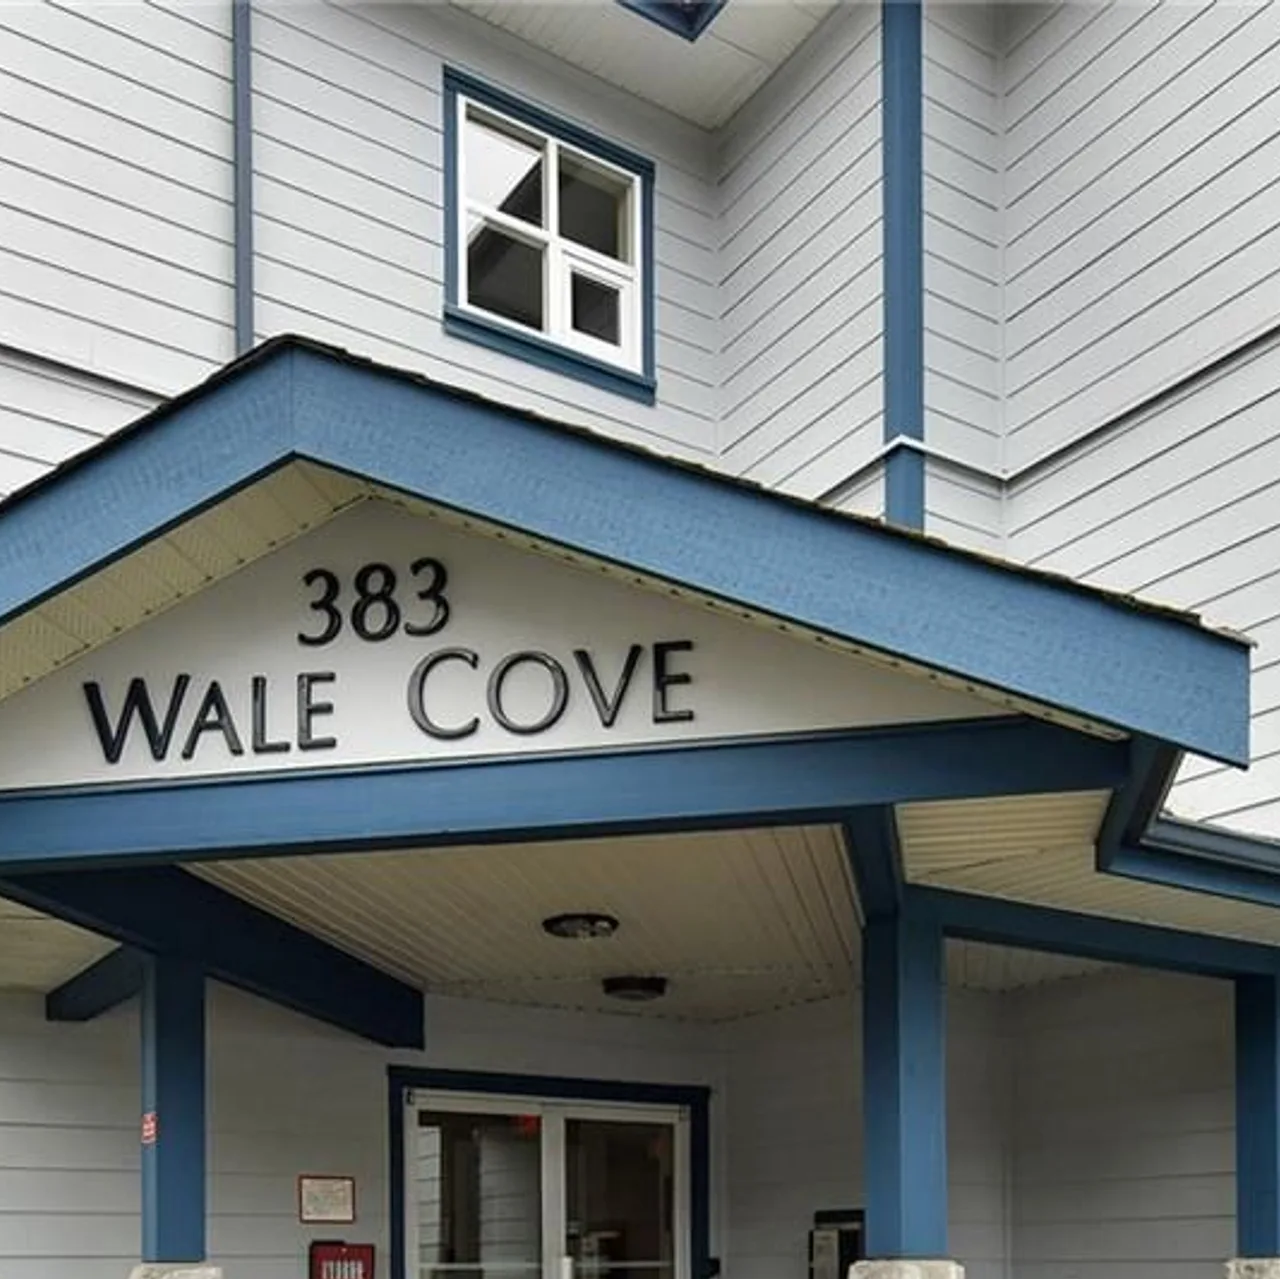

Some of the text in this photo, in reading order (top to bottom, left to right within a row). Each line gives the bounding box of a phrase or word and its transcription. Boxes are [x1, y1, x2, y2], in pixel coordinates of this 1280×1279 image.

[298, 557, 451, 646] 383
[83, 645, 695, 764] WALE COVE
